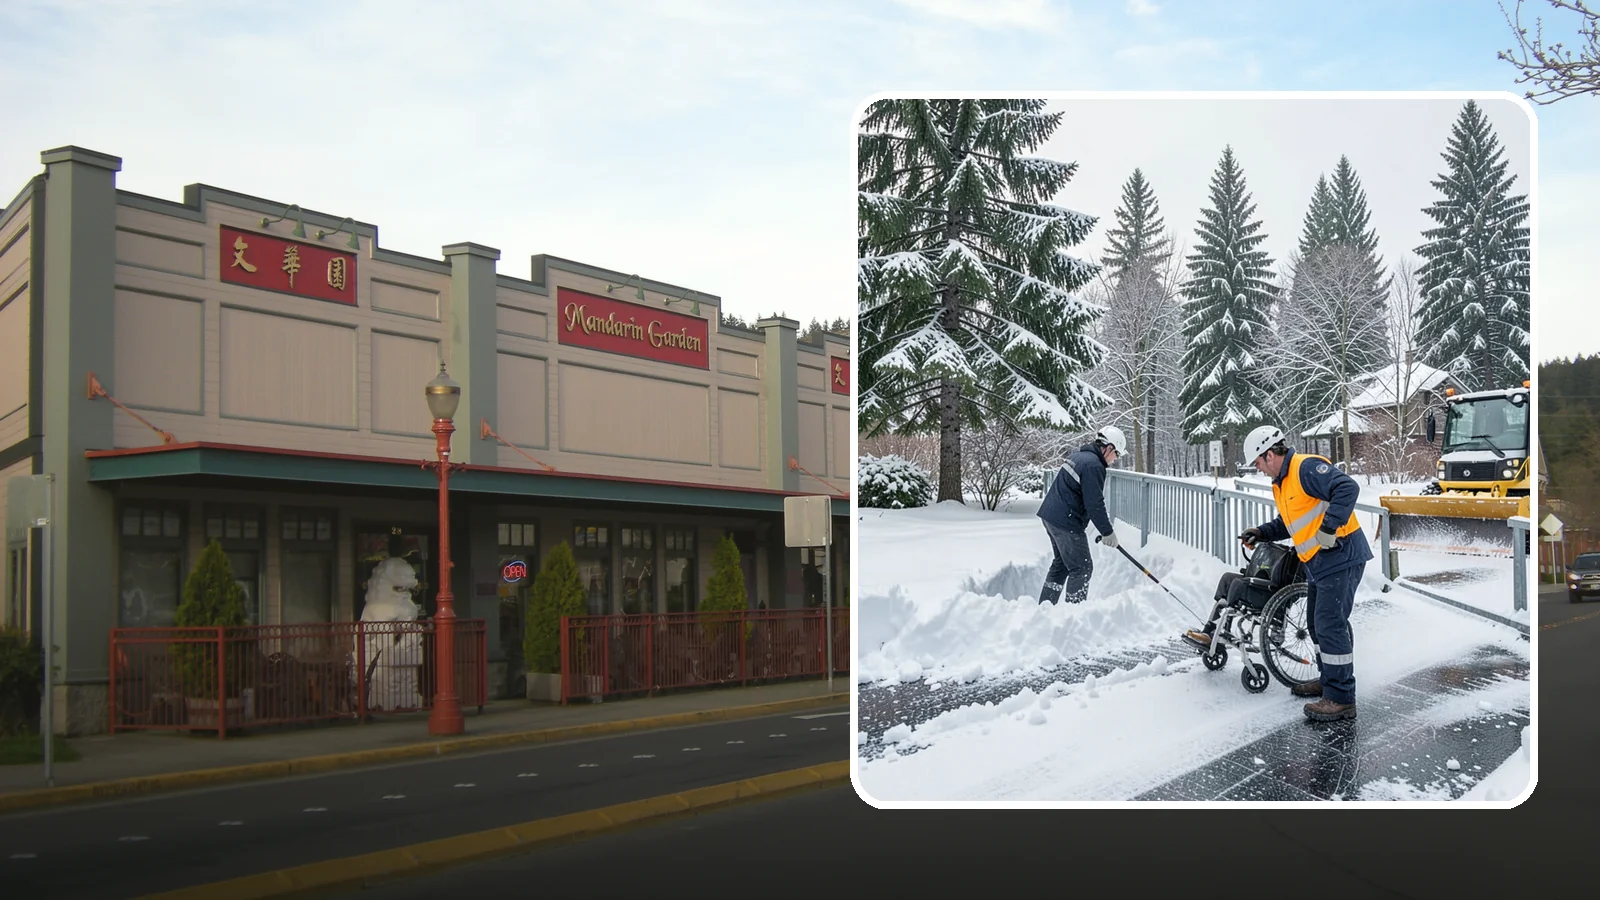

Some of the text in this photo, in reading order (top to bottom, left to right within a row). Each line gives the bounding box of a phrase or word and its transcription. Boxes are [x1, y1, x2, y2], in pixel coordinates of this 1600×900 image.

[231, 236, 346, 291] 文華園
[564, 303, 702, 352] Mandarin Garden
[503, 565, 527, 578] OPEN
